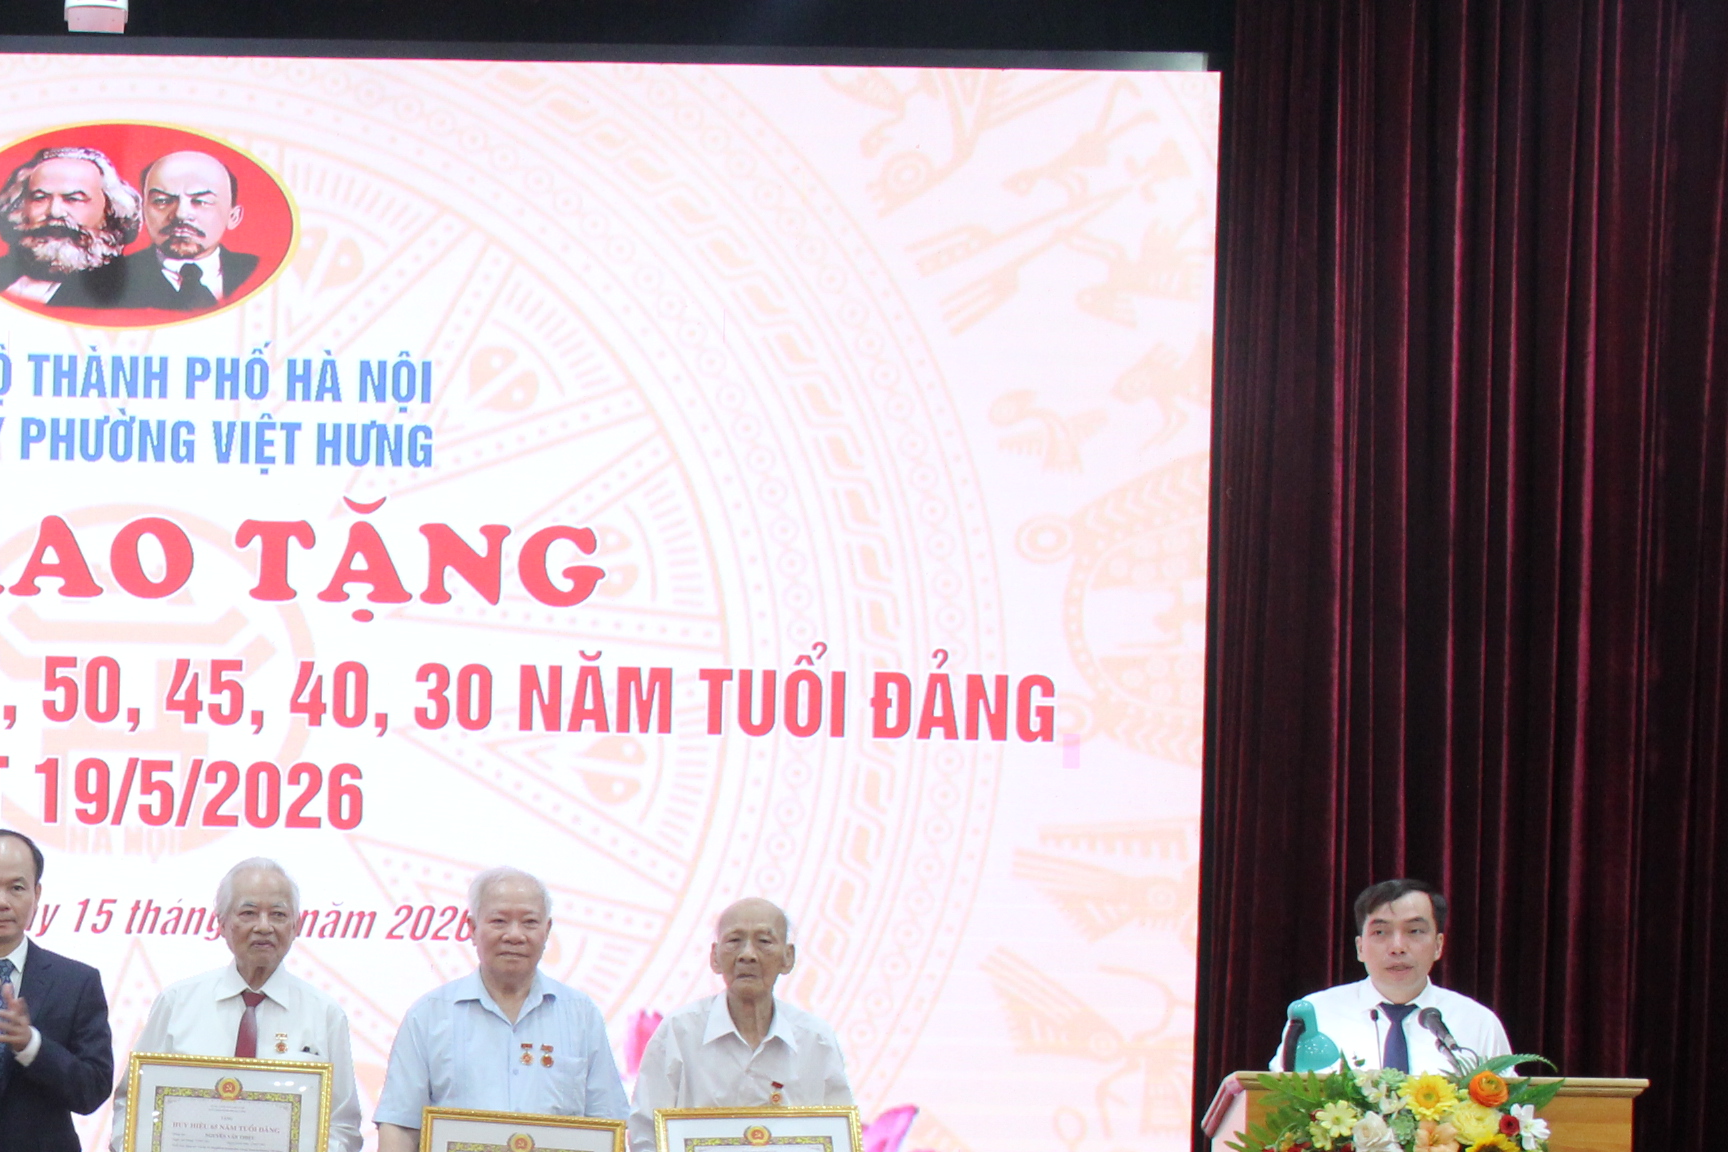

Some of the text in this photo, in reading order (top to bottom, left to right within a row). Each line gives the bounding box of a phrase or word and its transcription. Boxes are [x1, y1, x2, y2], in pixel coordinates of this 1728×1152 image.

[28, 346, 169, 399] THÀNH
[185, 341, 272, 401] PHỐ
[286, 350, 342, 402] HÀ
[359, 351, 432, 413] NỘI
[20, 408, 196, 464] PHƯỜNG
[212, 413, 303, 475] VIỆT
[316, 420, 433, 468] HƯNG
[235, 496, 605, 623] TẶNG
[43, 656, 141, 731] 50,
[166, 658, 264, 734] 45,
[290, 661, 388, 737] 40,
[415, 663, 491, 731] 30
[519, 650, 672, 734] NĂM
[699, 641, 846, 737] TUỔI
[870, 648, 1056, 742] ĐẢNG
[35, 757, 363, 830] 19/5/2026
[73, 898, 117, 934] 15
